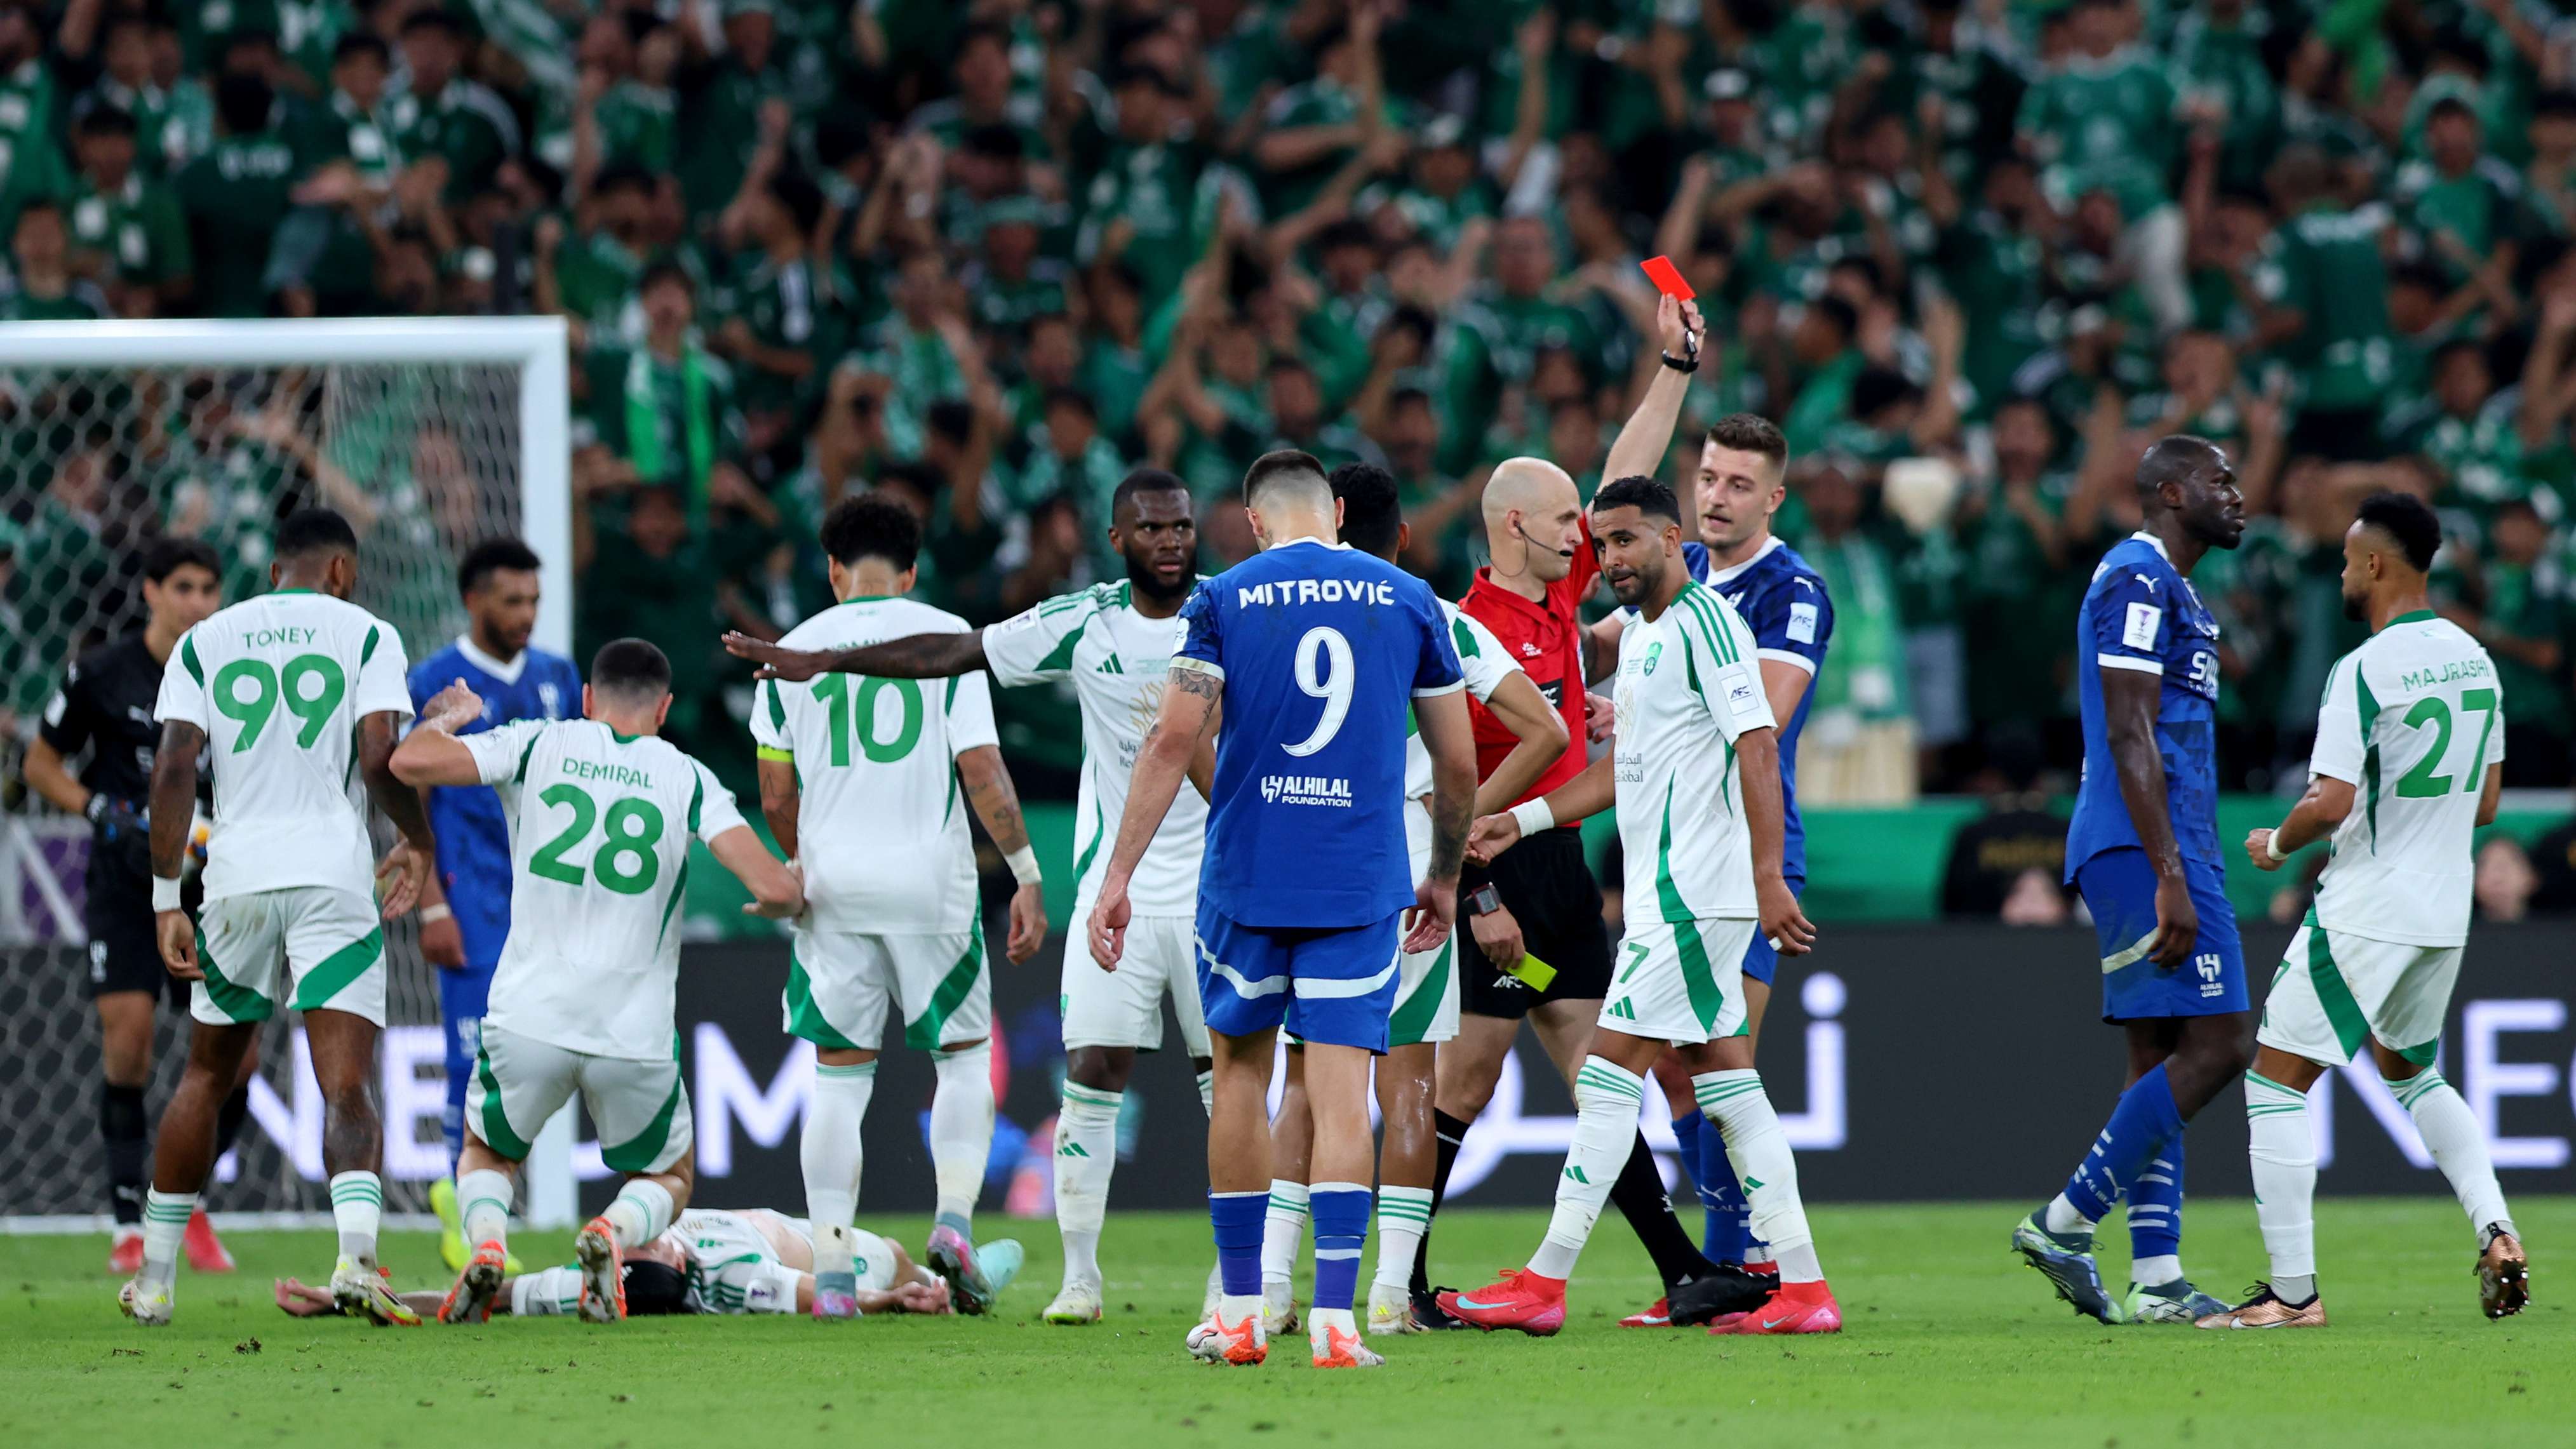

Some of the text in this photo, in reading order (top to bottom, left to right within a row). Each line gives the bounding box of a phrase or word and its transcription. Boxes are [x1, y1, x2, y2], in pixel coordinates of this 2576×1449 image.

[1238, 579, 1395, 610] MITROVIĆ
[243, 625, 317, 650] TONEY
[1280, 626, 1355, 757] 9
[2401, 659, 2490, 692] MAJRASHI
[213, 654, 345, 754] 99
[1730, 684, 1752, 700] AFC
[811, 672, 923, 766] 10
[2396, 688, 2497, 798] 27
[563, 758, 654, 789] DEMIRAL
[1283, 776, 1352, 798] ALHILAL
[1282, 796, 1352, 808] FOUNDATION
[529, 783, 664, 895] 28
[1618, 942, 1650, 984] 7
[1493, 975, 1523, 989] AFC
